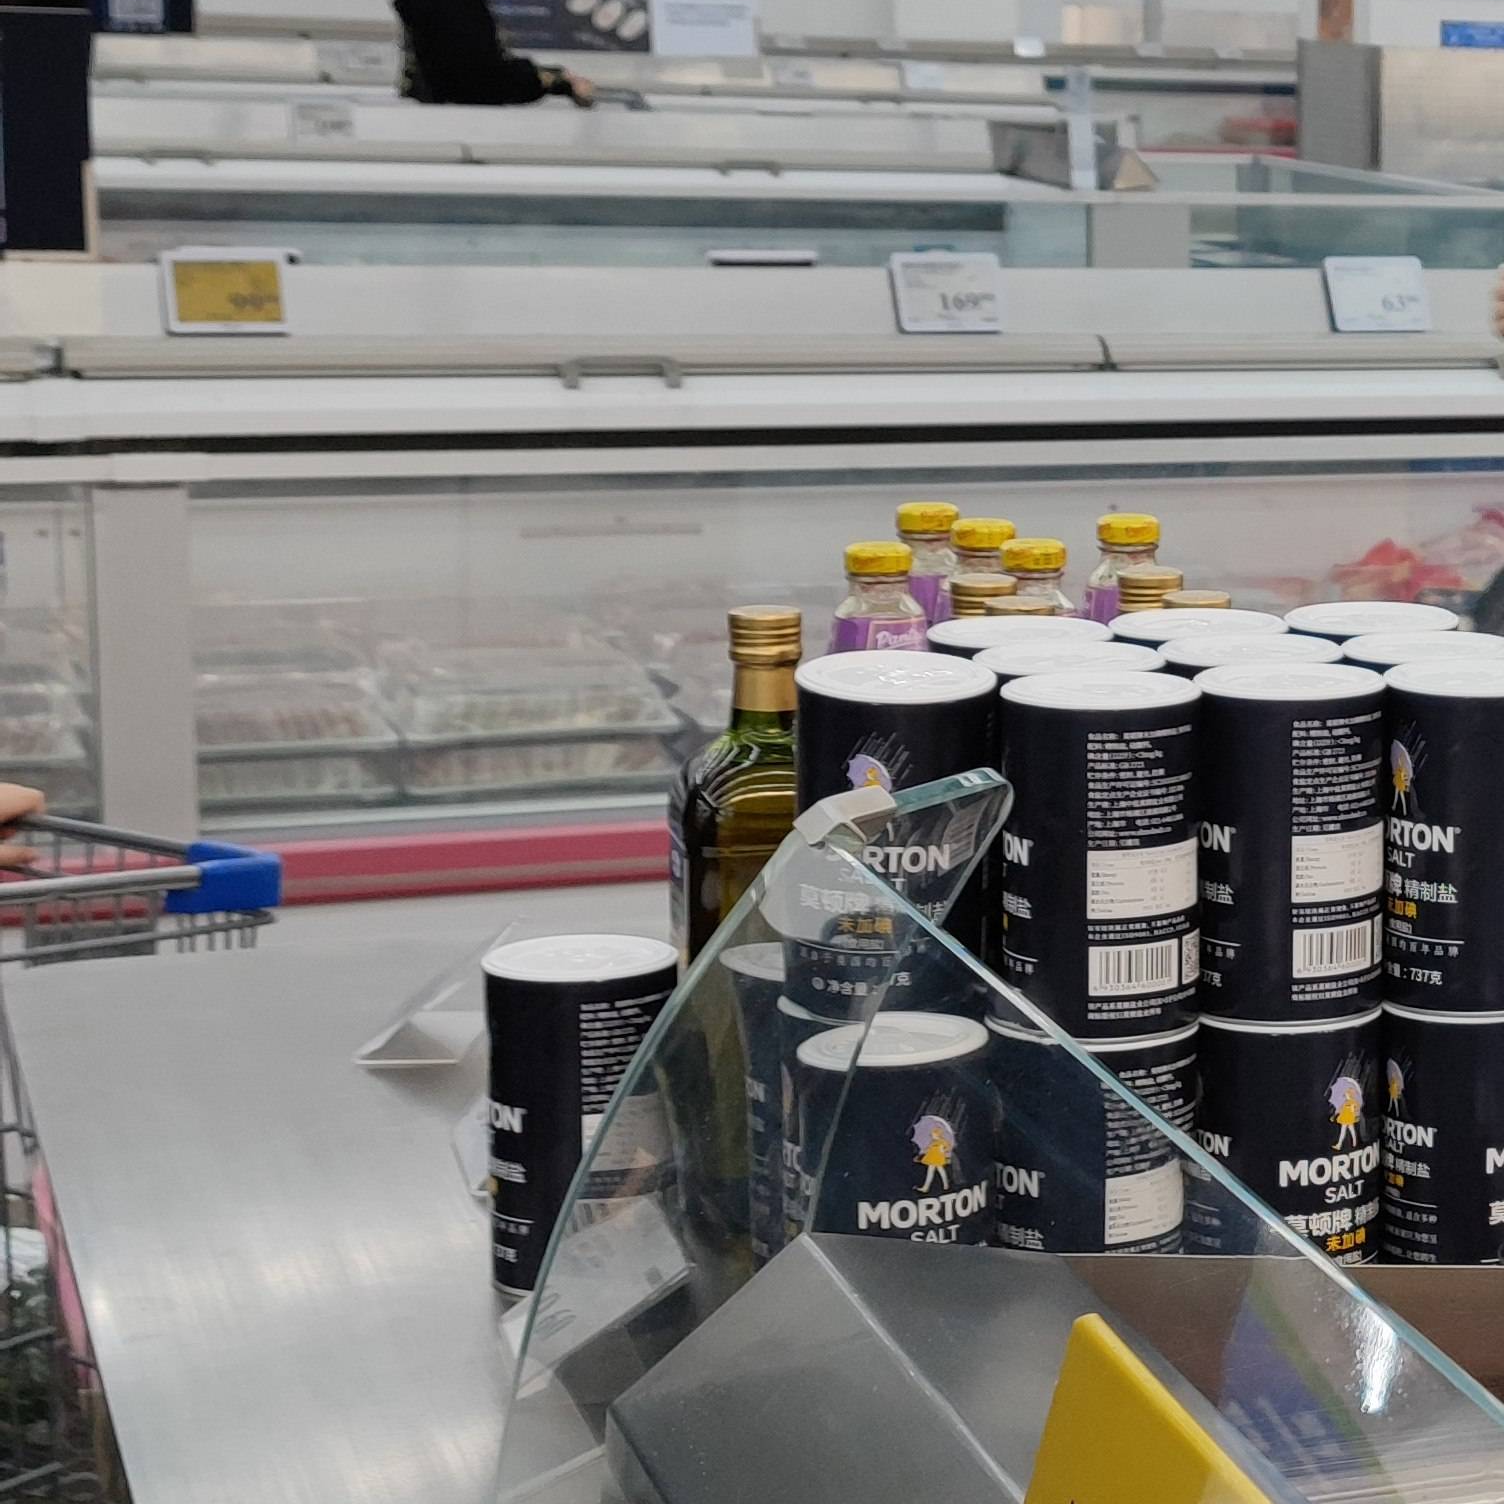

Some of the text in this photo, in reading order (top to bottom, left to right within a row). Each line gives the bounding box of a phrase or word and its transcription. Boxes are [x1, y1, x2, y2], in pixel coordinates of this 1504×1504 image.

[1386, 817, 1455, 853] RTON
[1278, 1141, 1381, 1188] MORTON
[857, 1179, 989, 1231] MORTON
[1324, 1179, 1366, 1205] SALT
[910, 1224, 960, 1244] SALT
[1325, 1226, 1367, 1253] 未加碘
